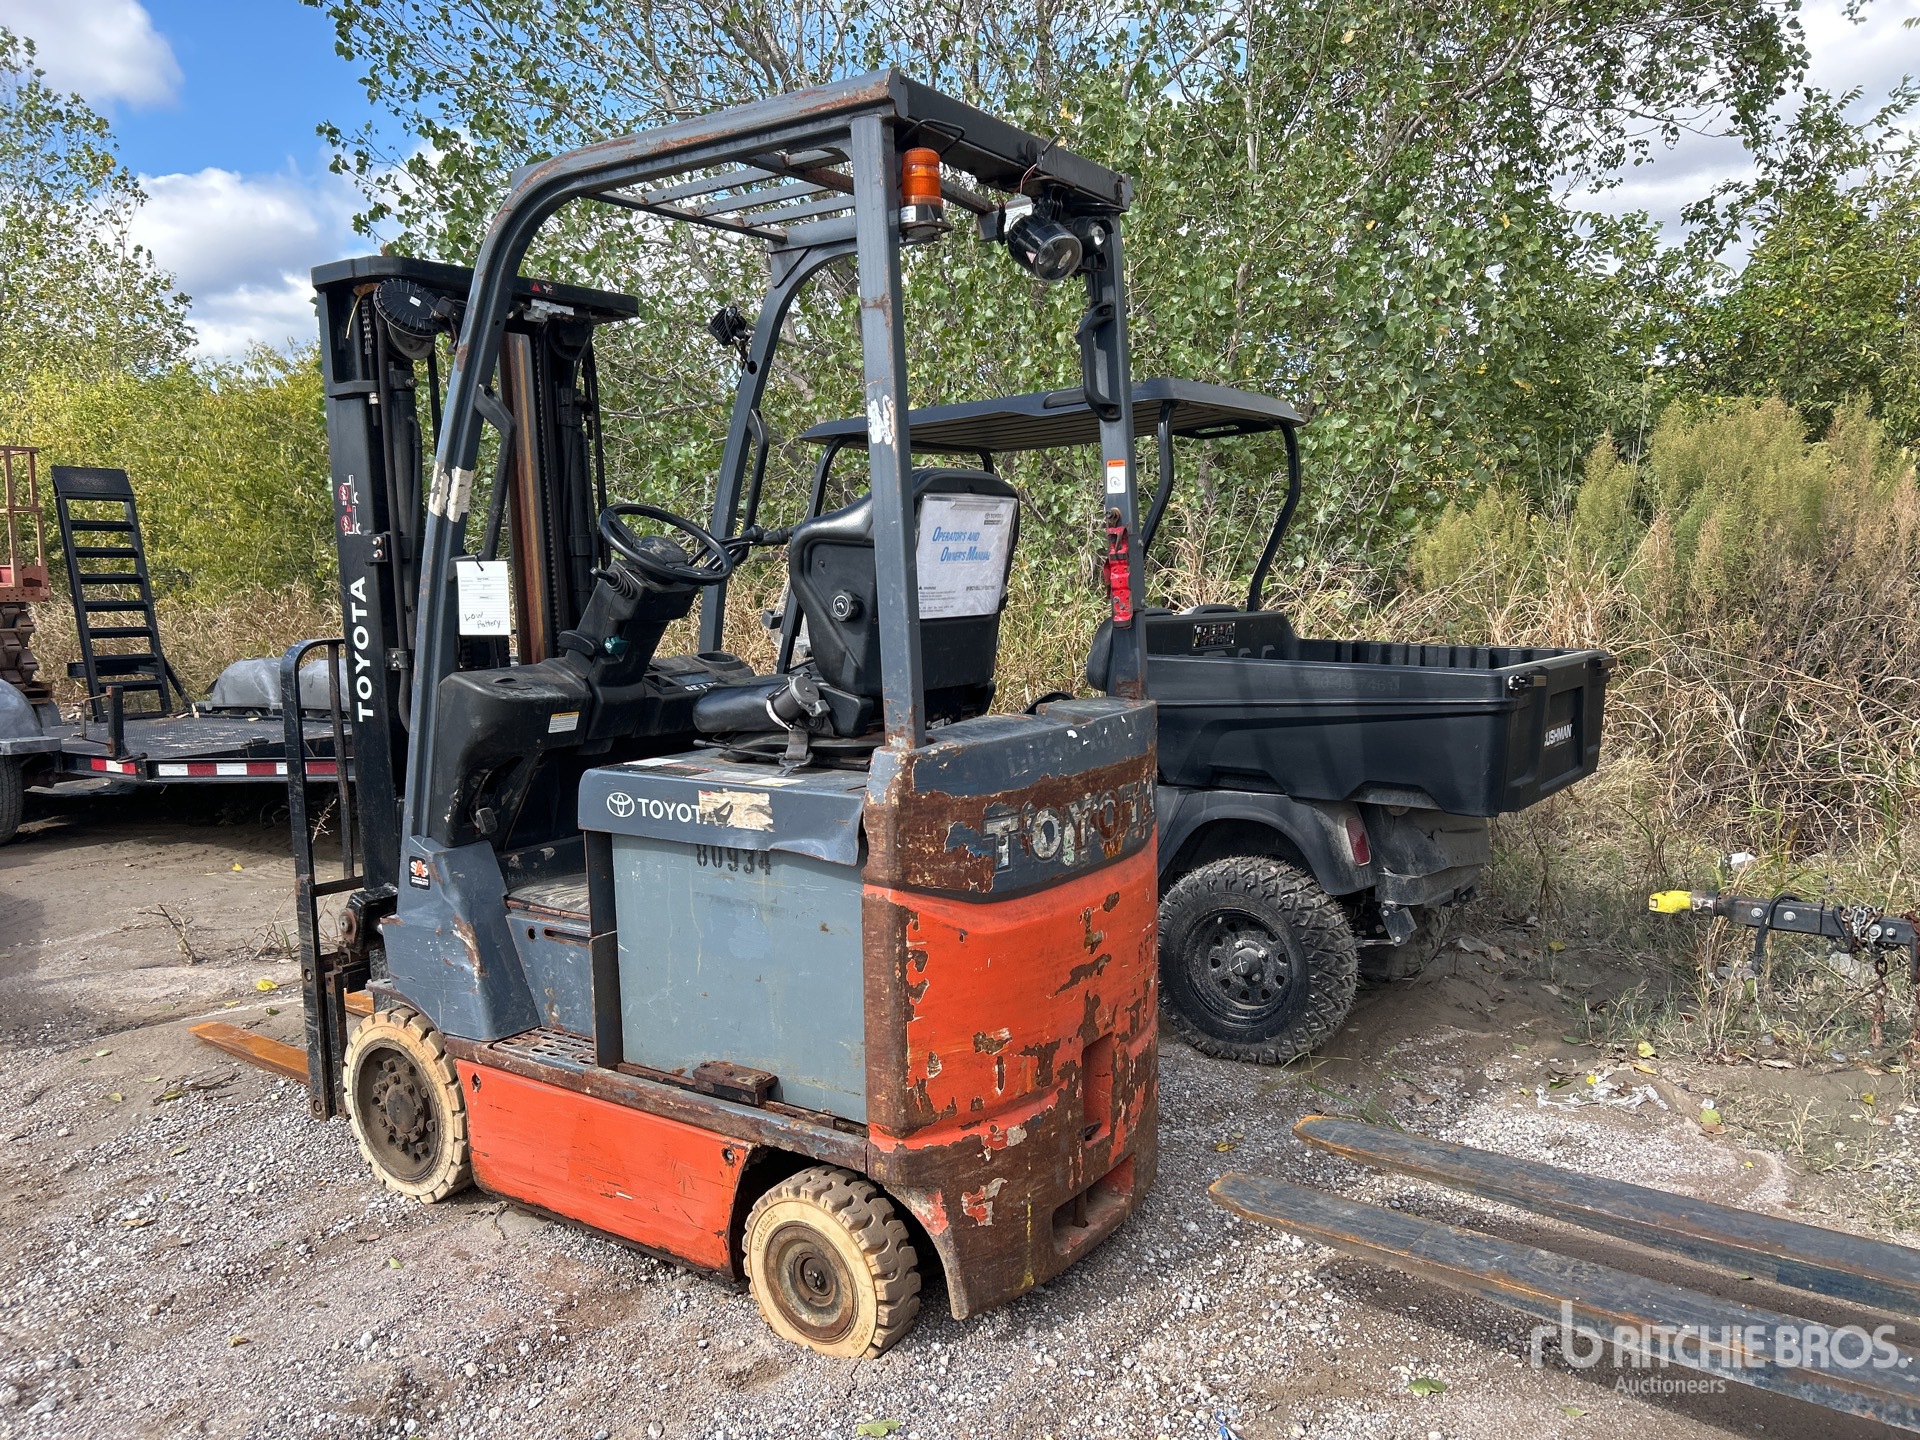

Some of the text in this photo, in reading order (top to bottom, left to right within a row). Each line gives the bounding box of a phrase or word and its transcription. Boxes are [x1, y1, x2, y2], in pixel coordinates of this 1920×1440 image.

[965, 546, 991, 561] MANUAL
[350, 576, 374, 722] TOYOTA
[637, 797, 708, 825] TOYOT
